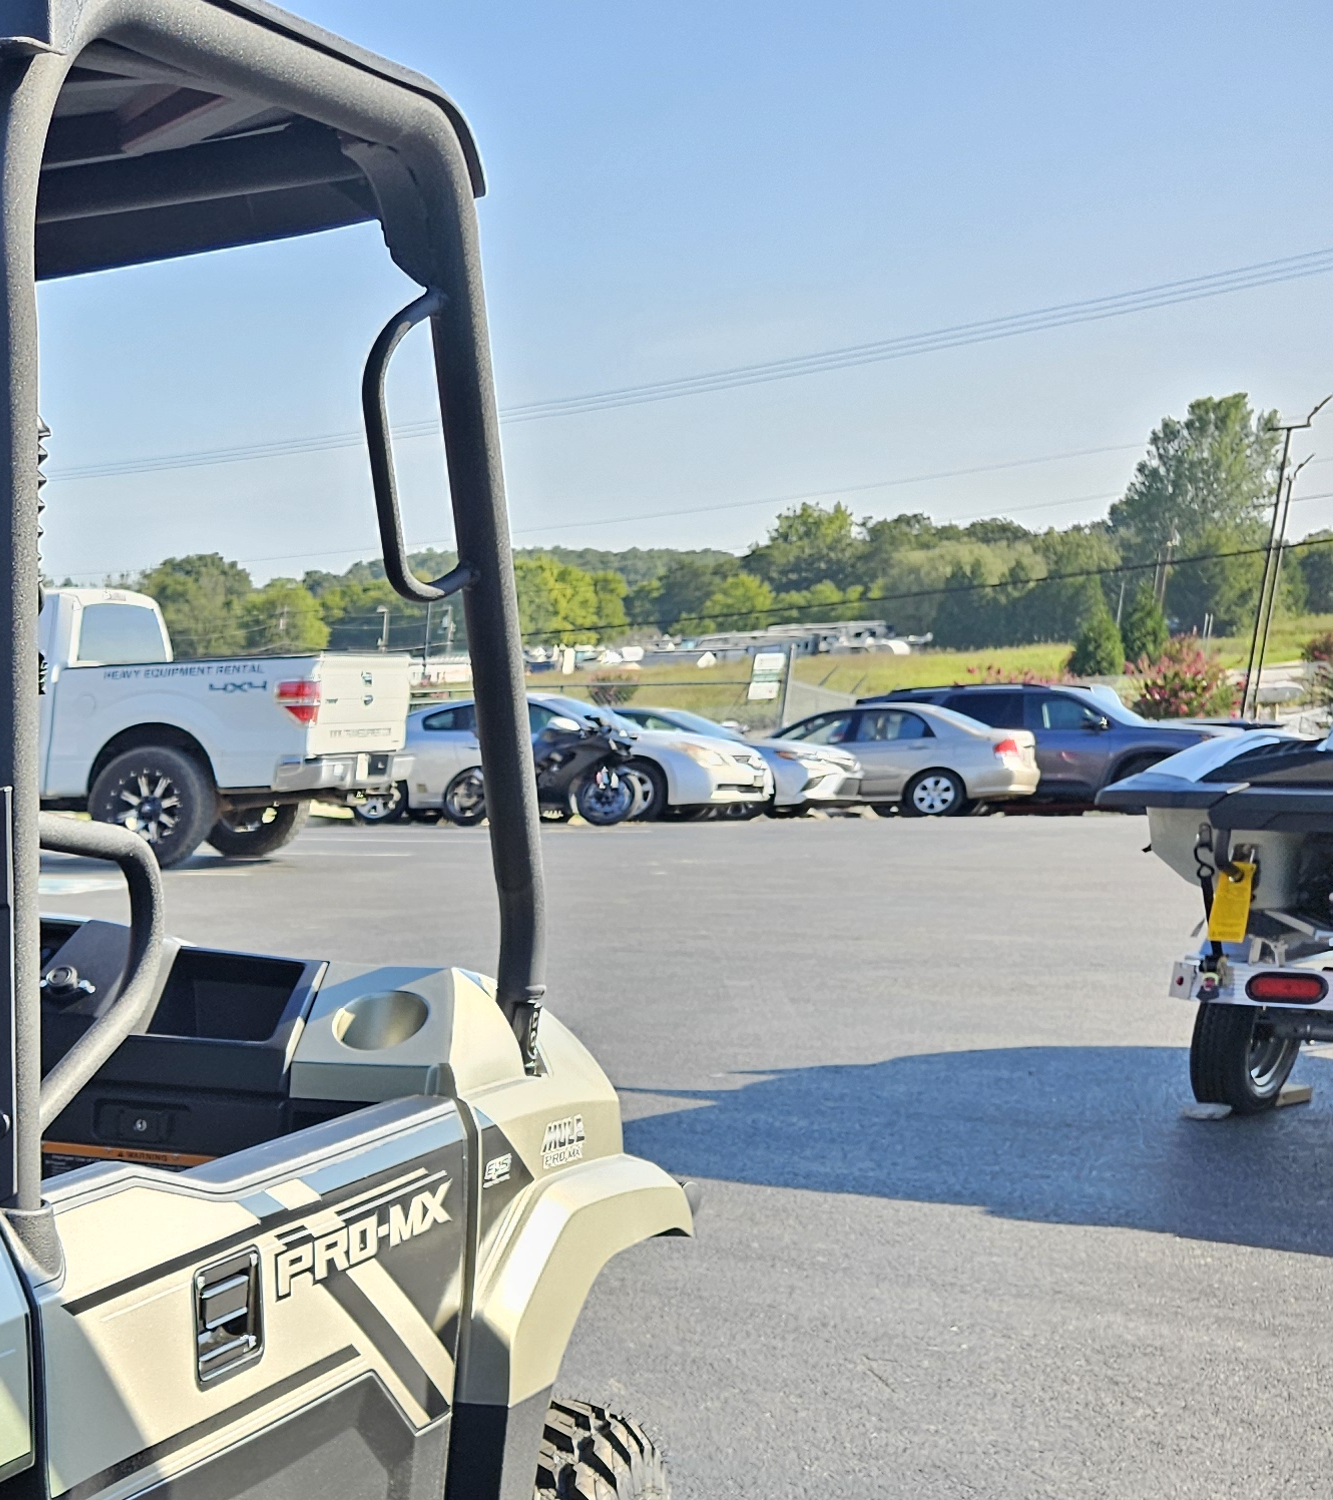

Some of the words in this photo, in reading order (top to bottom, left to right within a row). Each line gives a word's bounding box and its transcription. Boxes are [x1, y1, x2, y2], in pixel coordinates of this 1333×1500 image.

[103, 668, 140, 680] HEAVY
[144, 665, 213, 678] EQUIPMENT
[216, 663, 265, 675] RENTAL
[541, 1114, 585, 1155] MULE
[127, 1151, 168, 1162] WARNING
[276, 1176, 454, 1299] PRO-MX
